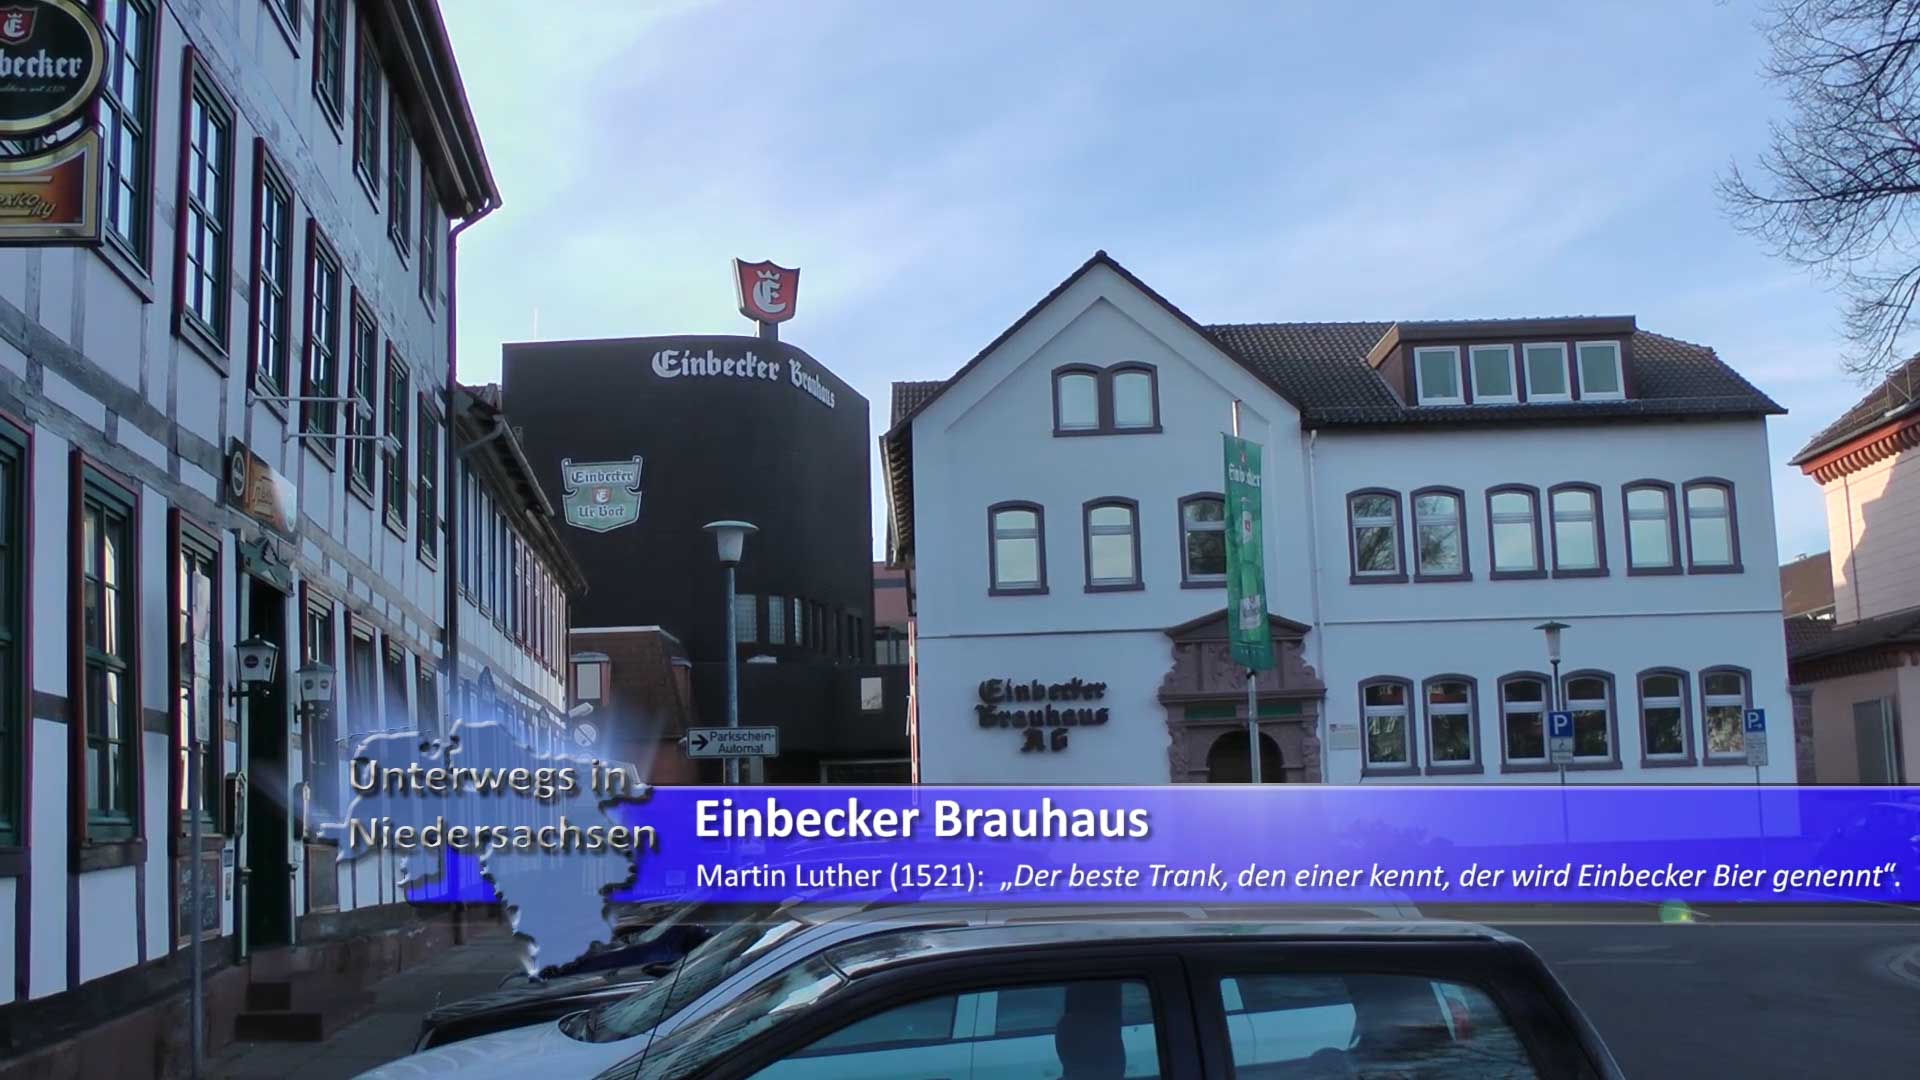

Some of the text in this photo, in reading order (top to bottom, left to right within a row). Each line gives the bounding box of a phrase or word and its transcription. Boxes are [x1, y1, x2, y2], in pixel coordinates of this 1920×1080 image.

[651, 349, 836, 409] Einbecker Brauhaus
[571, 469, 634, 484] Einbecker
[978, 676, 1107, 704] Einbecker
[974, 703, 1110, 729] Brauhaus
[1554, 714, 1568, 735] P
[1747, 711, 1760, 729] P
[710, 730, 776, 742] Parkschein-
[718, 743, 765, 754] Automat
